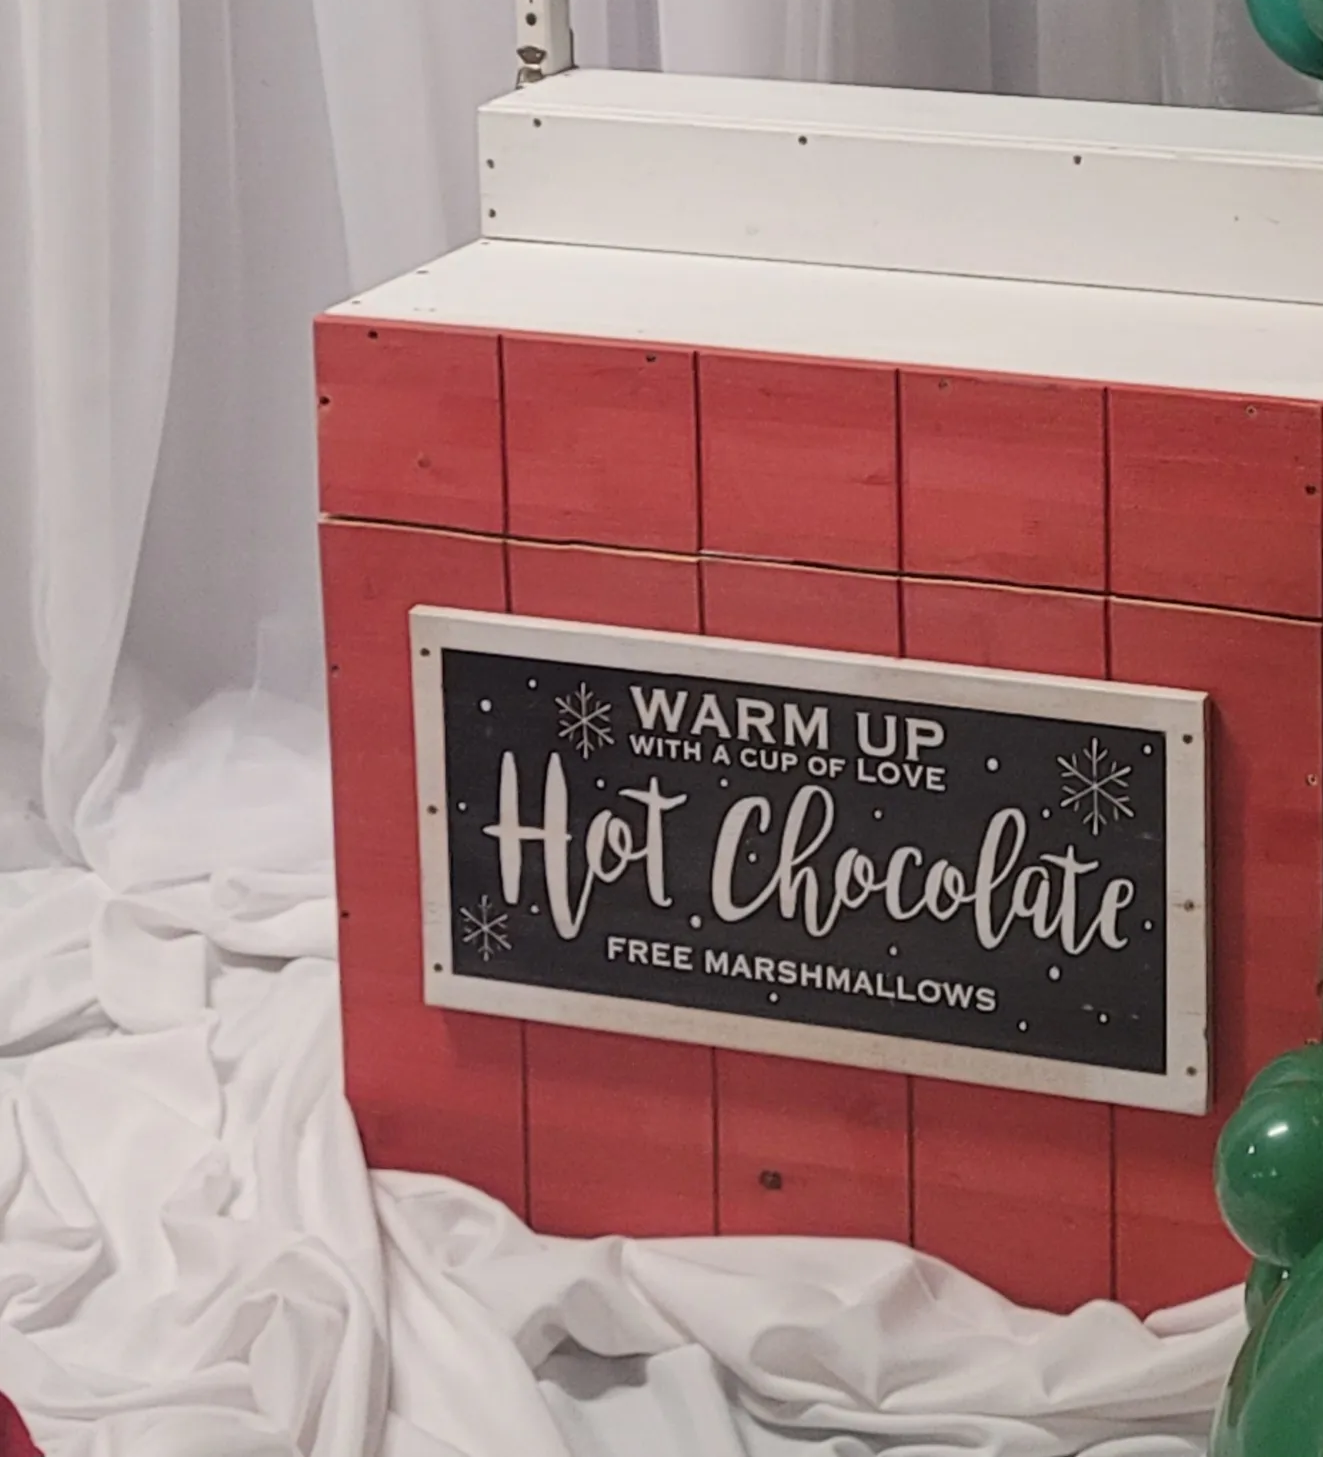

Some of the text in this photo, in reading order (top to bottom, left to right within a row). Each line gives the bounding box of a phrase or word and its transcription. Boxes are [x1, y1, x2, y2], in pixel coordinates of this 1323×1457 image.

[629, 685, 945, 762] WARM UP
[629, 733, 946, 792] WITH A CUP OF LOVE
[482, 750, 1135, 956] Hot Chocolate
[606, 935, 998, 1012] FREE MARSHMALLOWS
